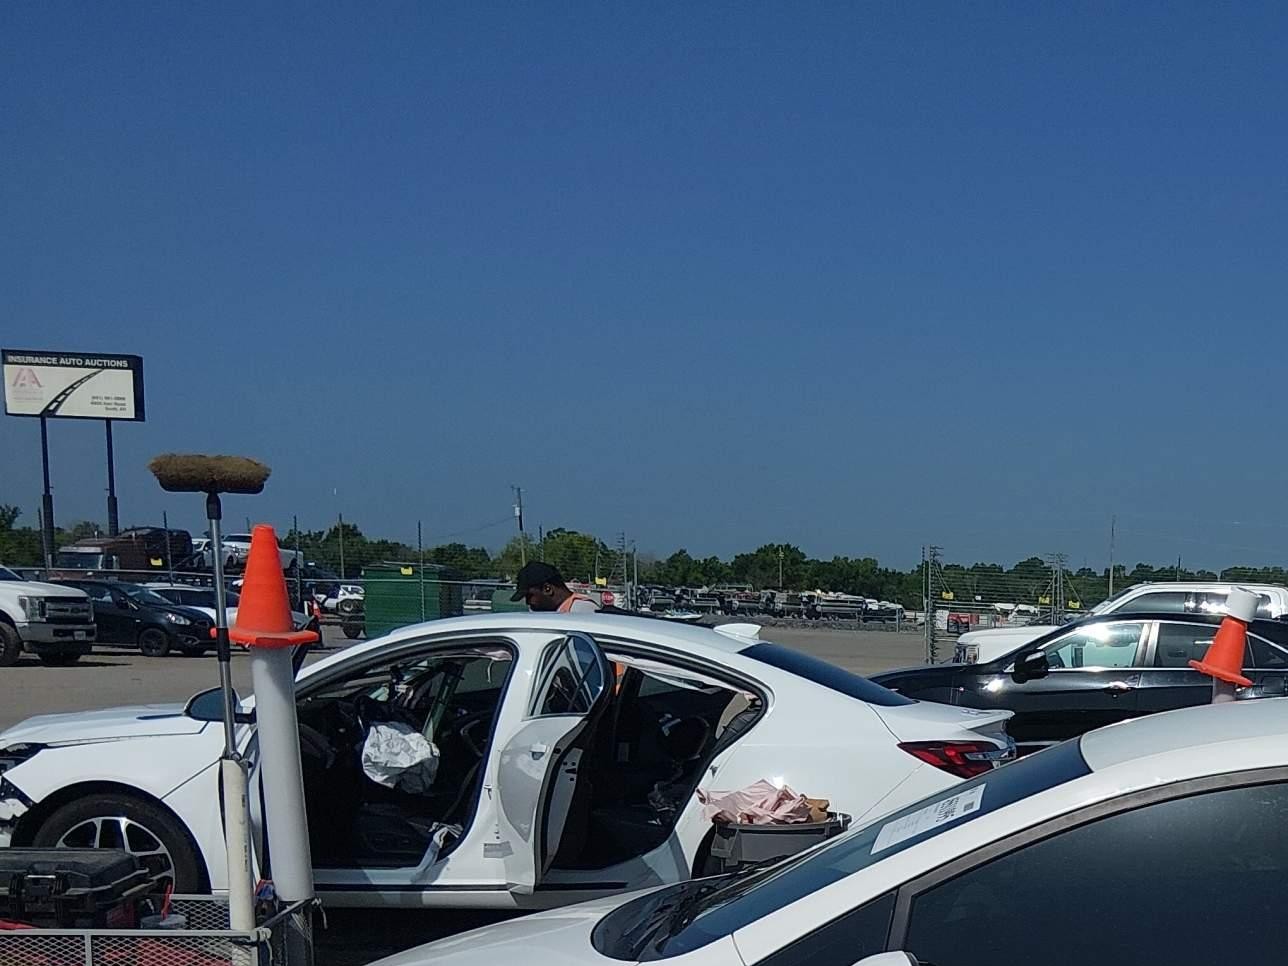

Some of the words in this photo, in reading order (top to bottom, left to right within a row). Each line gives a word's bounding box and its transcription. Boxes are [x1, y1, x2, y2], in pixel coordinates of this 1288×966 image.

[7, 355, 58, 365] INSURANCE
[59, 357, 83, 366] AUTO
[85, 359, 129, 368] AUCTIONS
